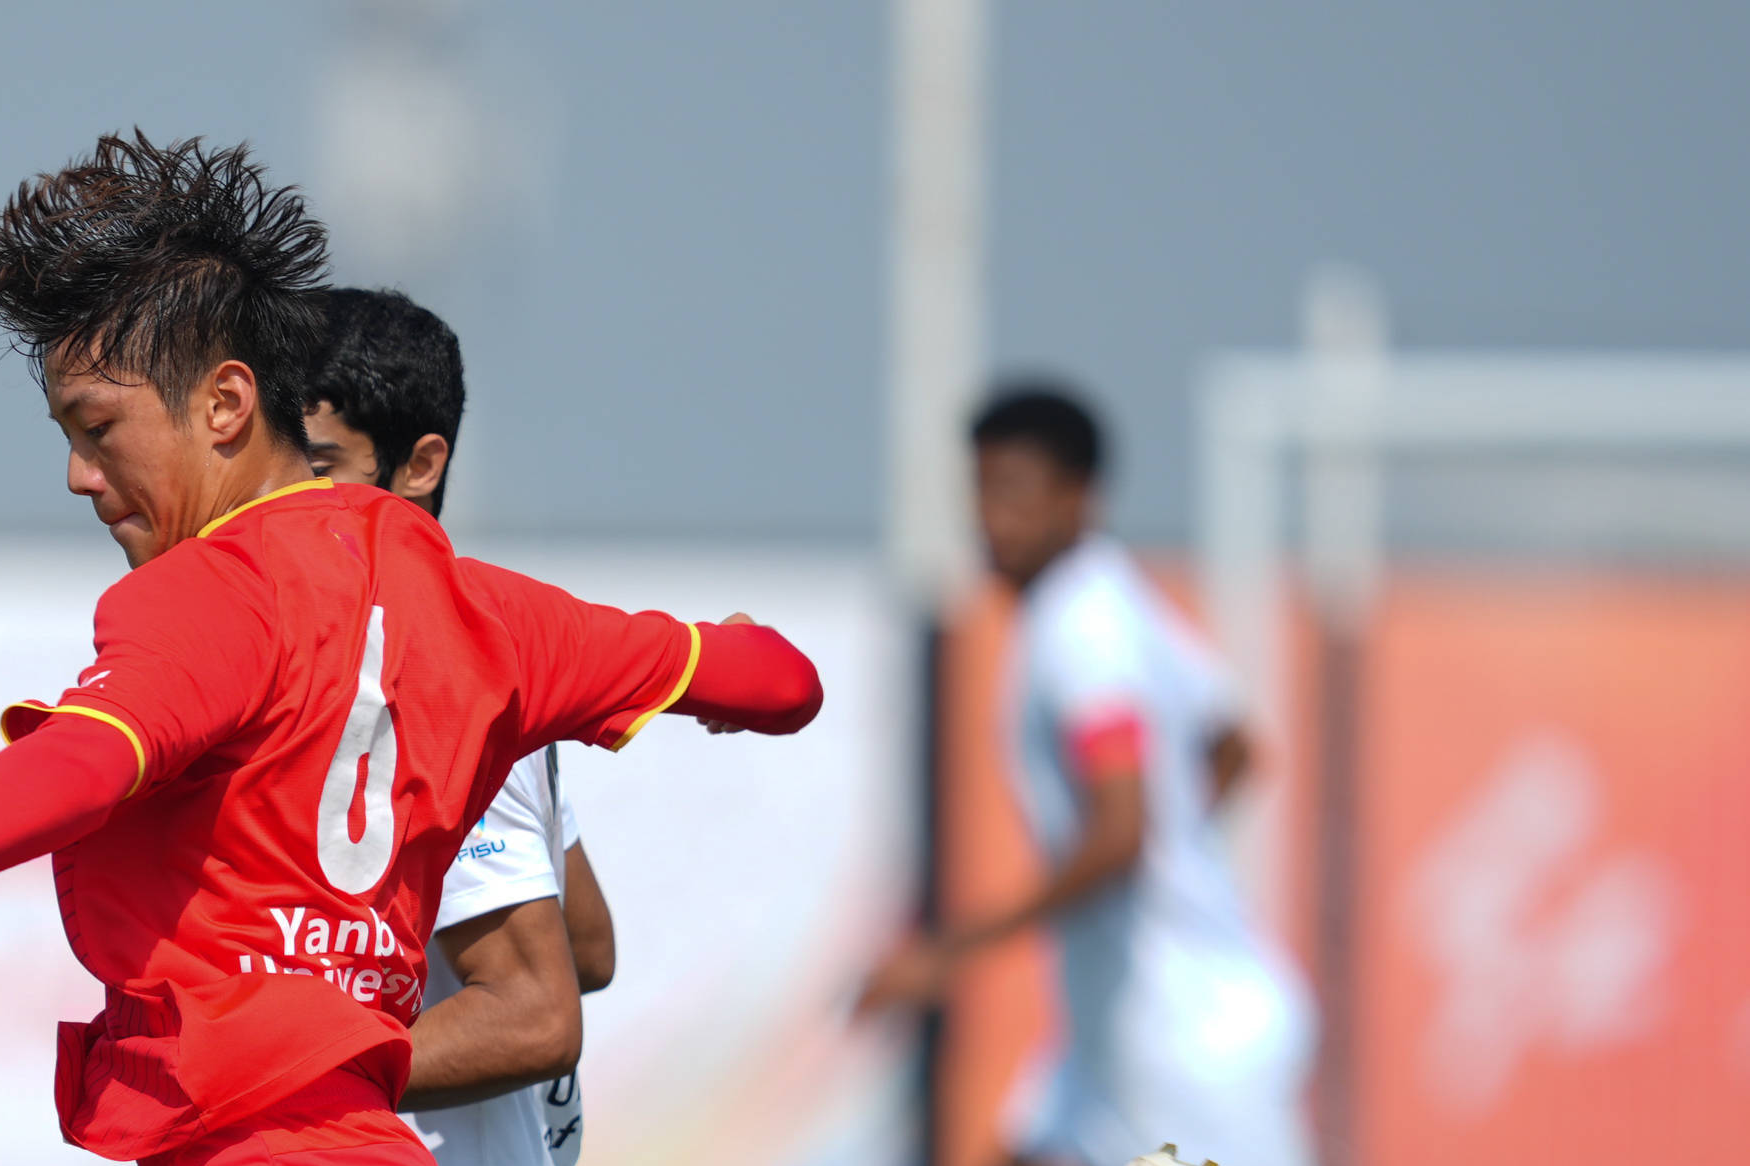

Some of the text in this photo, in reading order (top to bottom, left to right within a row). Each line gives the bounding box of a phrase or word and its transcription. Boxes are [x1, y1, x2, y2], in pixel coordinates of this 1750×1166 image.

[317, 605, 397, 895] 6
[457, 839, 506, 862] FISU
[270, 907, 405, 957] Yanb
